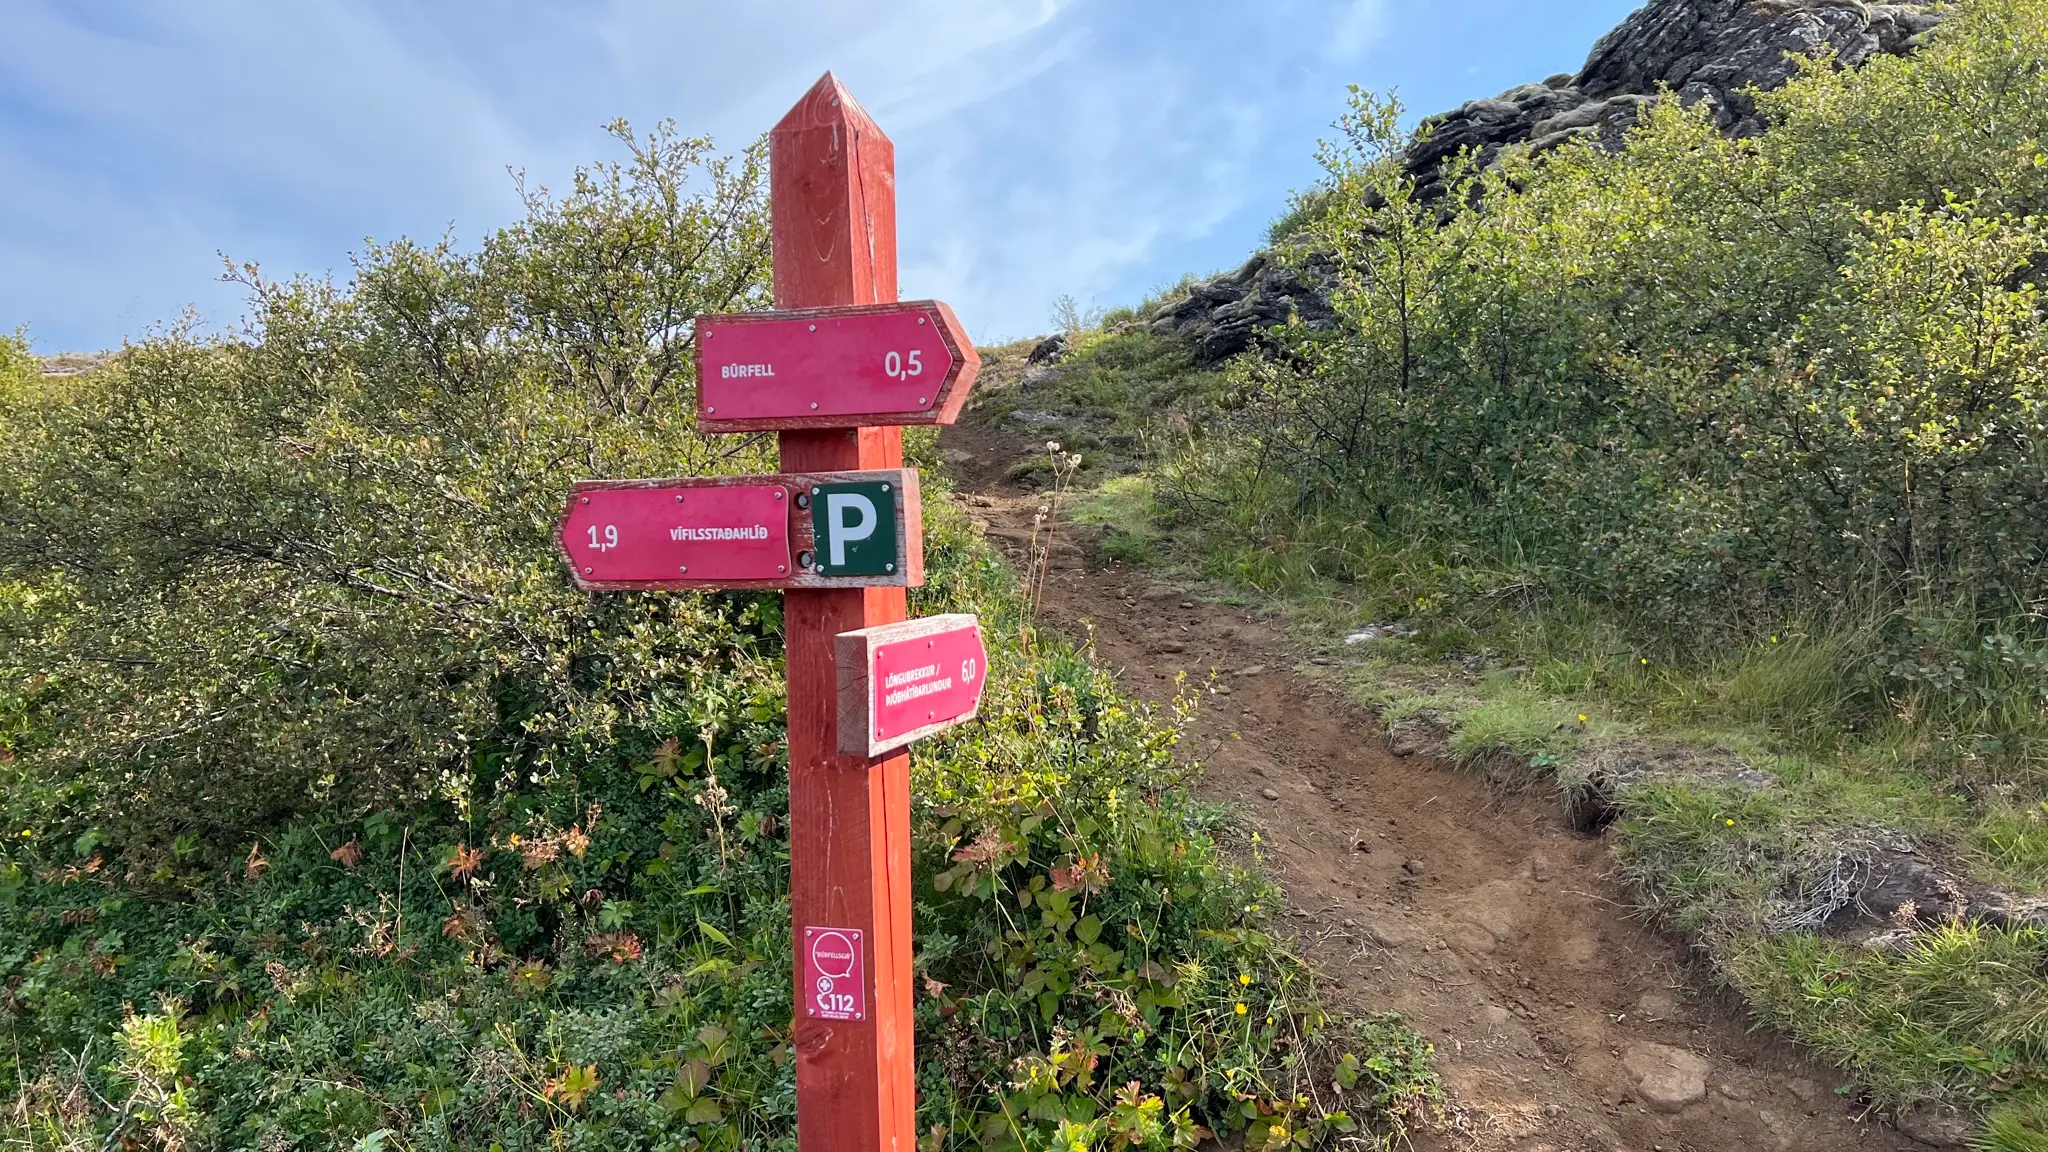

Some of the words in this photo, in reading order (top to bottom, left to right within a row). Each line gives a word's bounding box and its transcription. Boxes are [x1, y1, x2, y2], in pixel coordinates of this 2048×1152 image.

[721, 363, 775, 378] BÚRFELL
[884, 350, 922, 381] 0,5
[586, 525, 619, 552] 1,9
[827, 493, 877, 566] P
[961, 658, 976, 684] 6,0
[829, 993, 854, 1012] 112
